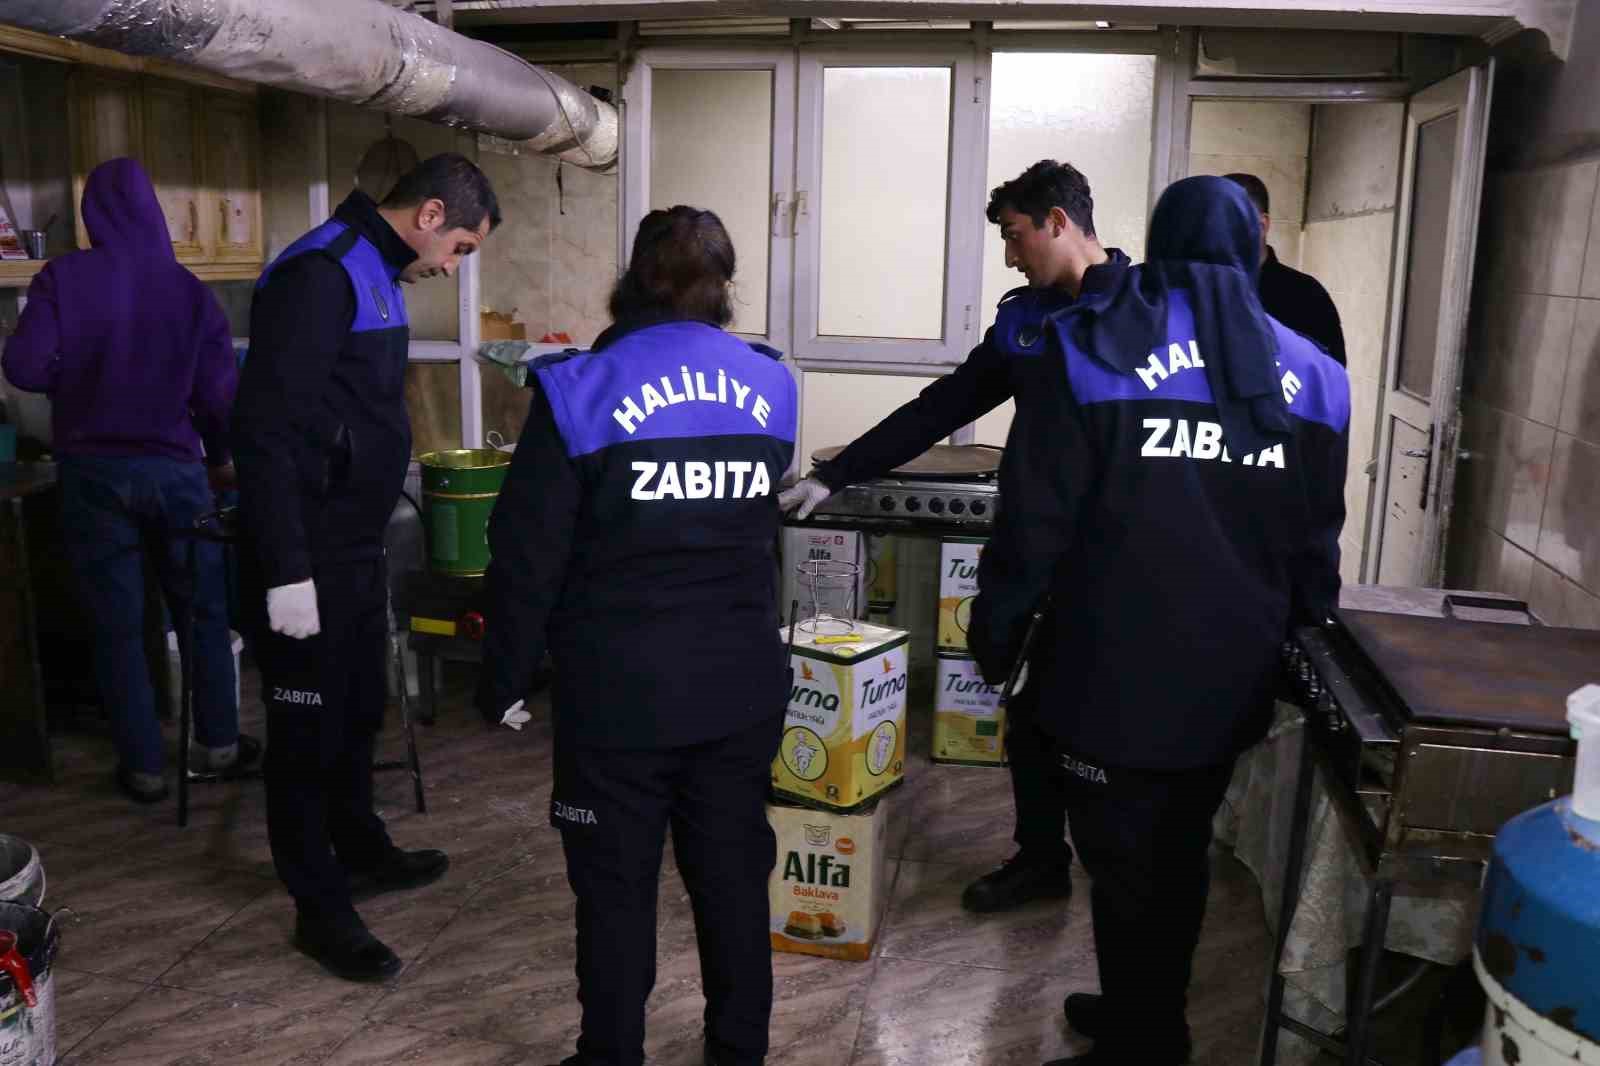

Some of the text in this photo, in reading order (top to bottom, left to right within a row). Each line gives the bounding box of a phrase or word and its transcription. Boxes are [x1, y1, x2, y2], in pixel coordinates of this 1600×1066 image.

[613, 365, 772, 435] HALİLİYE
[1141, 418, 1285, 469] ZABA
[631, 461, 770, 500] ZABITA
[808, 548, 832, 560] Alfa
[273, 687, 322, 705] ZABITA
[860, 673, 906, 709] Turna
[1062, 753, 1107, 784] ZABITA
[554, 800, 598, 824] ZABITA
[783, 850, 850, 888] Alfa
[793, 884, 839, 901] Baklava
